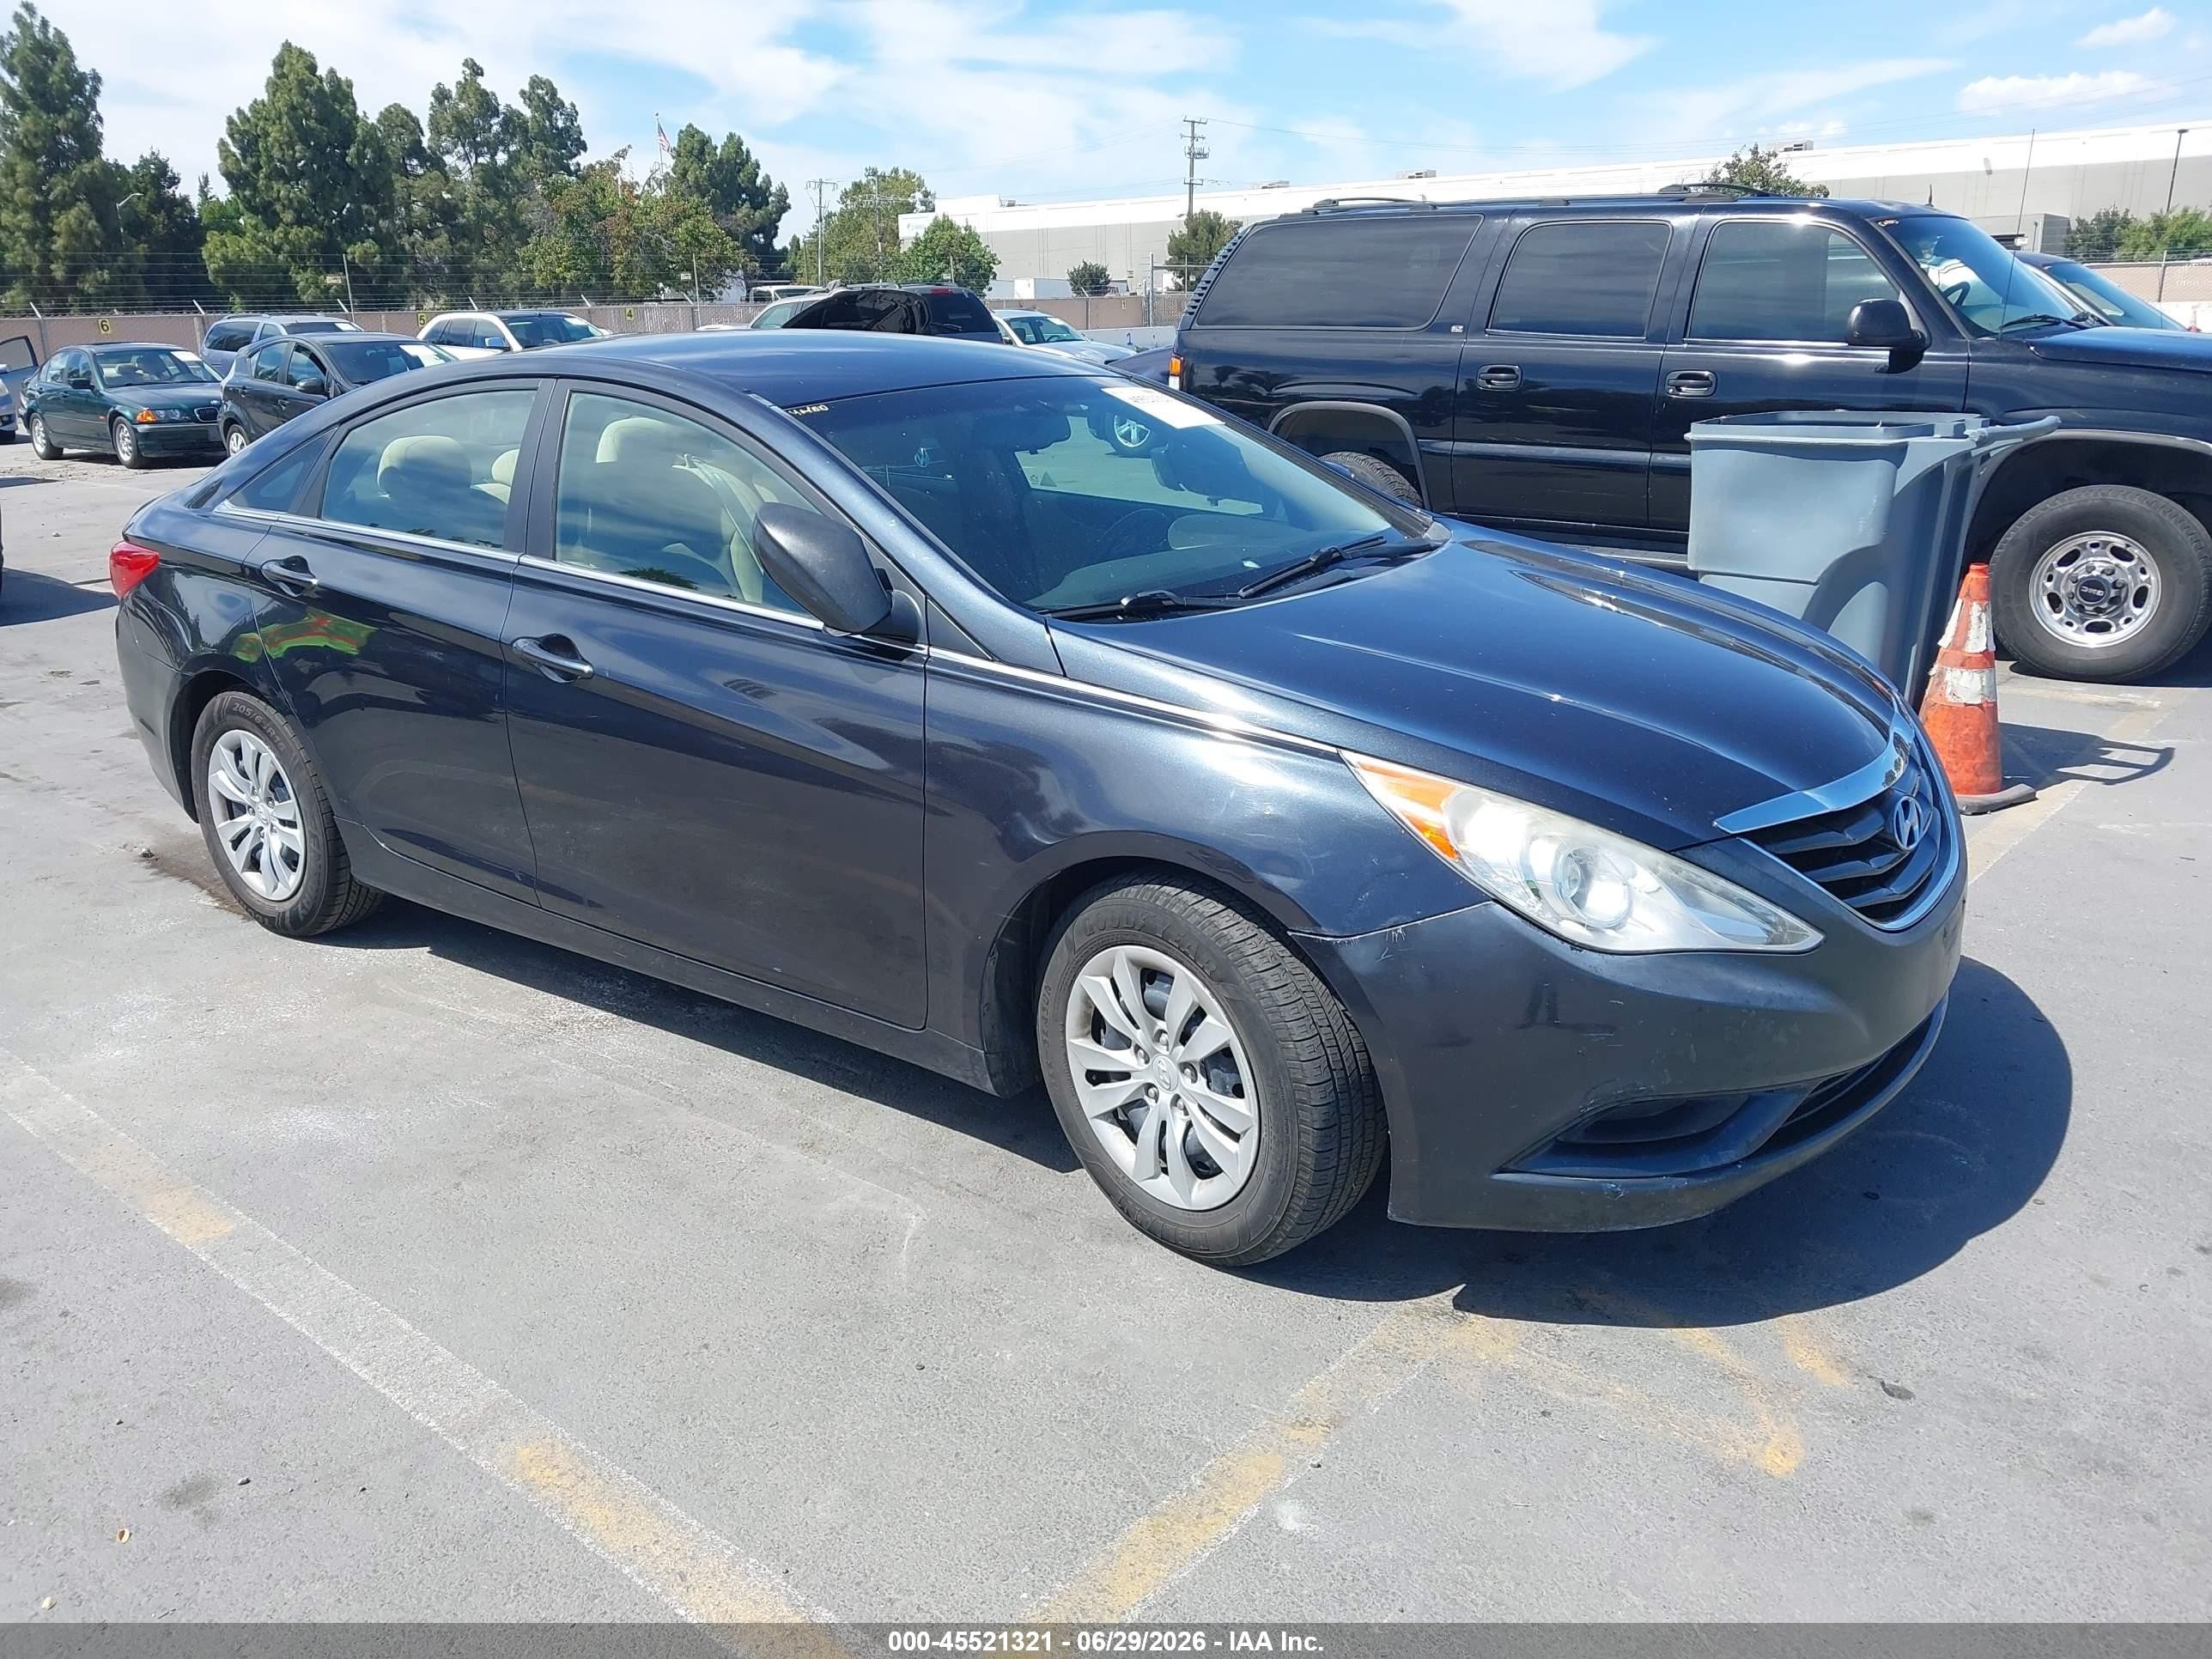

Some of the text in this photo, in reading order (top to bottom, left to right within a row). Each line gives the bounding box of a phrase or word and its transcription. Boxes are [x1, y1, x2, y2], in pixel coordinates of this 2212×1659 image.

[419, 314, 425, 325] 5
[627, 309, 633, 319] 4
[100, 320, 110, 331] 6
[1126, 332, 1133, 346] 1
